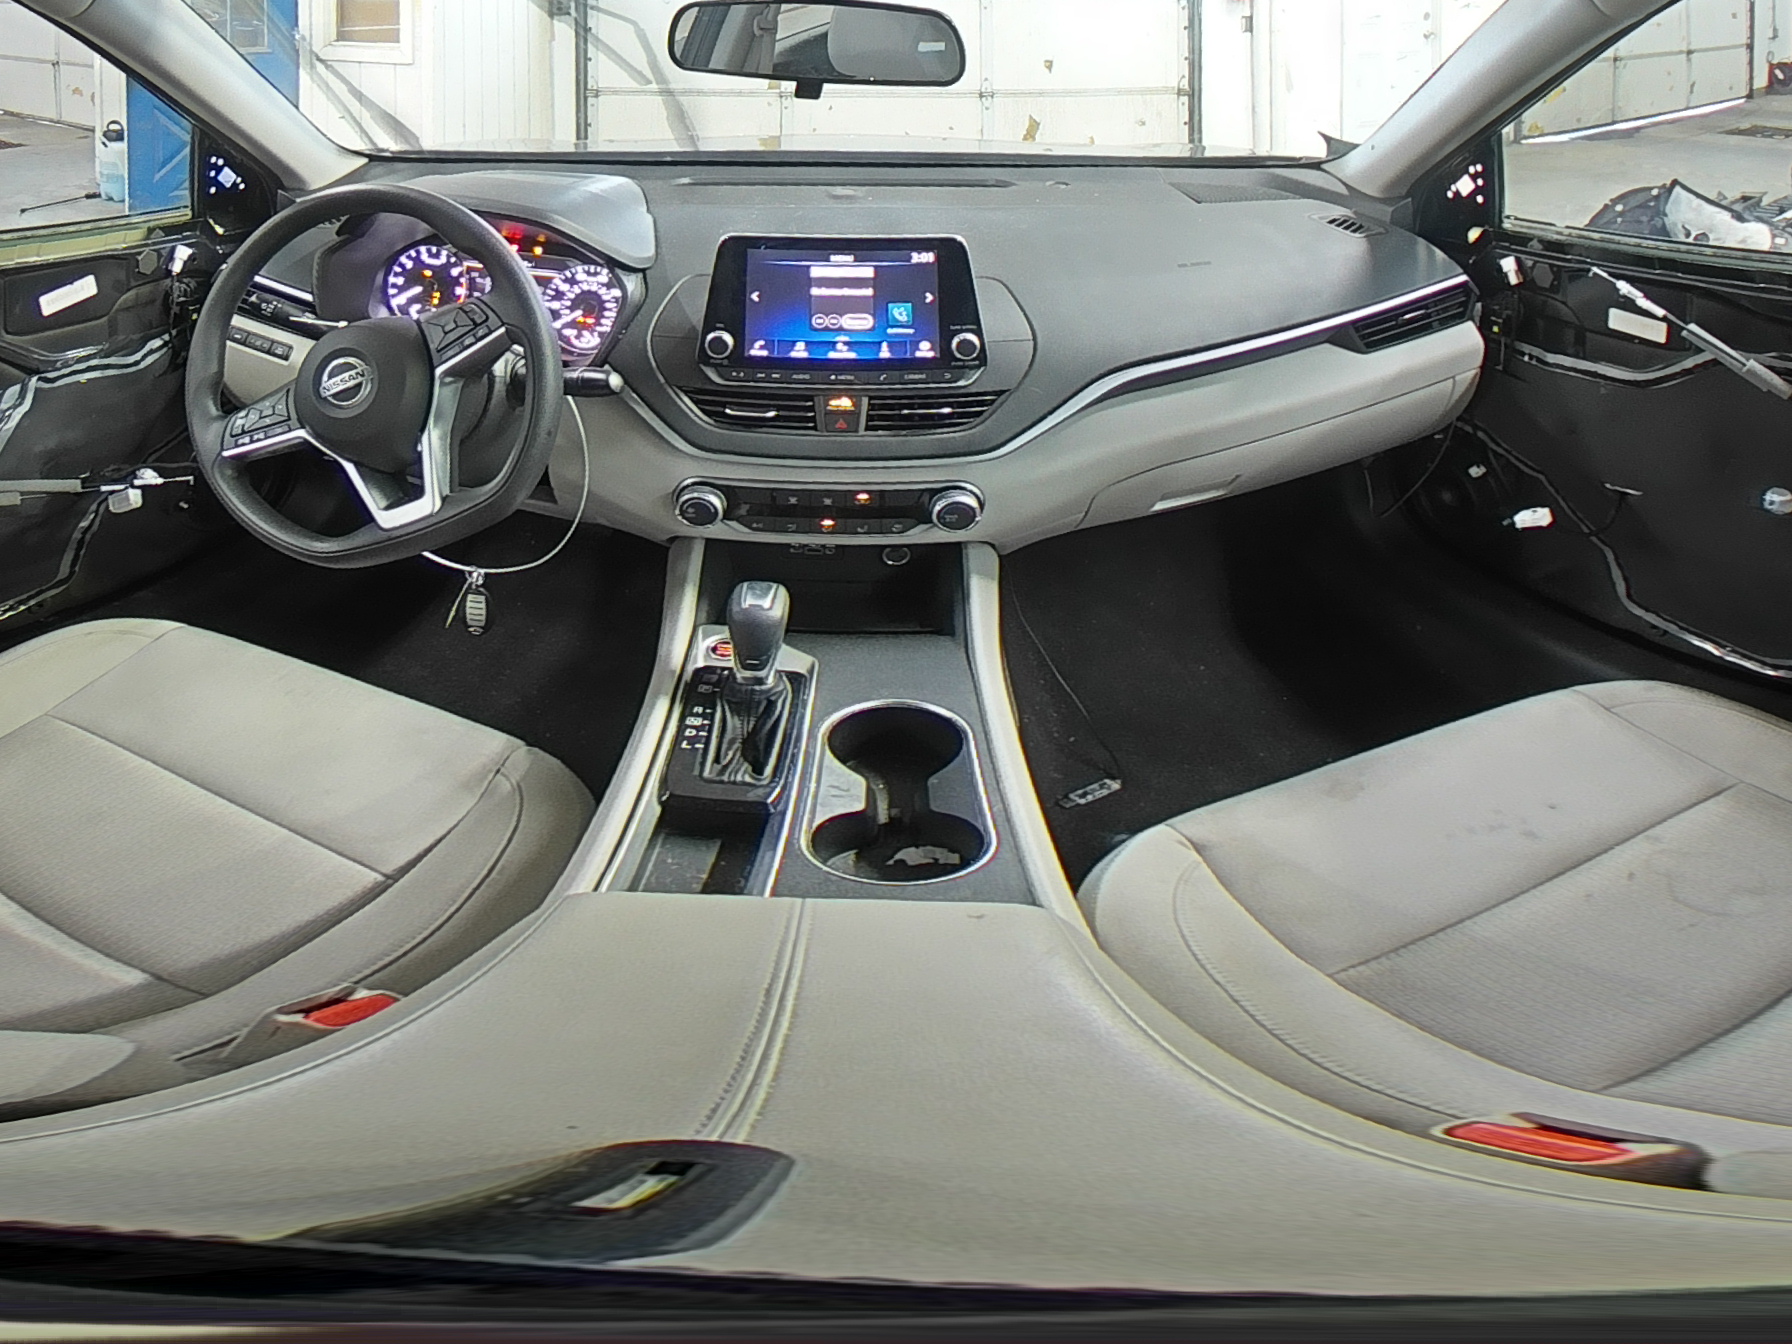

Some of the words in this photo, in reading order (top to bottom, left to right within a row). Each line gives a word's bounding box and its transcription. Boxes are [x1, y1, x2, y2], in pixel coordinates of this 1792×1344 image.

[321, 370, 365, 394] NISSAN
[684, 728, 697, 736] D
[681, 740, 692, 749] L
